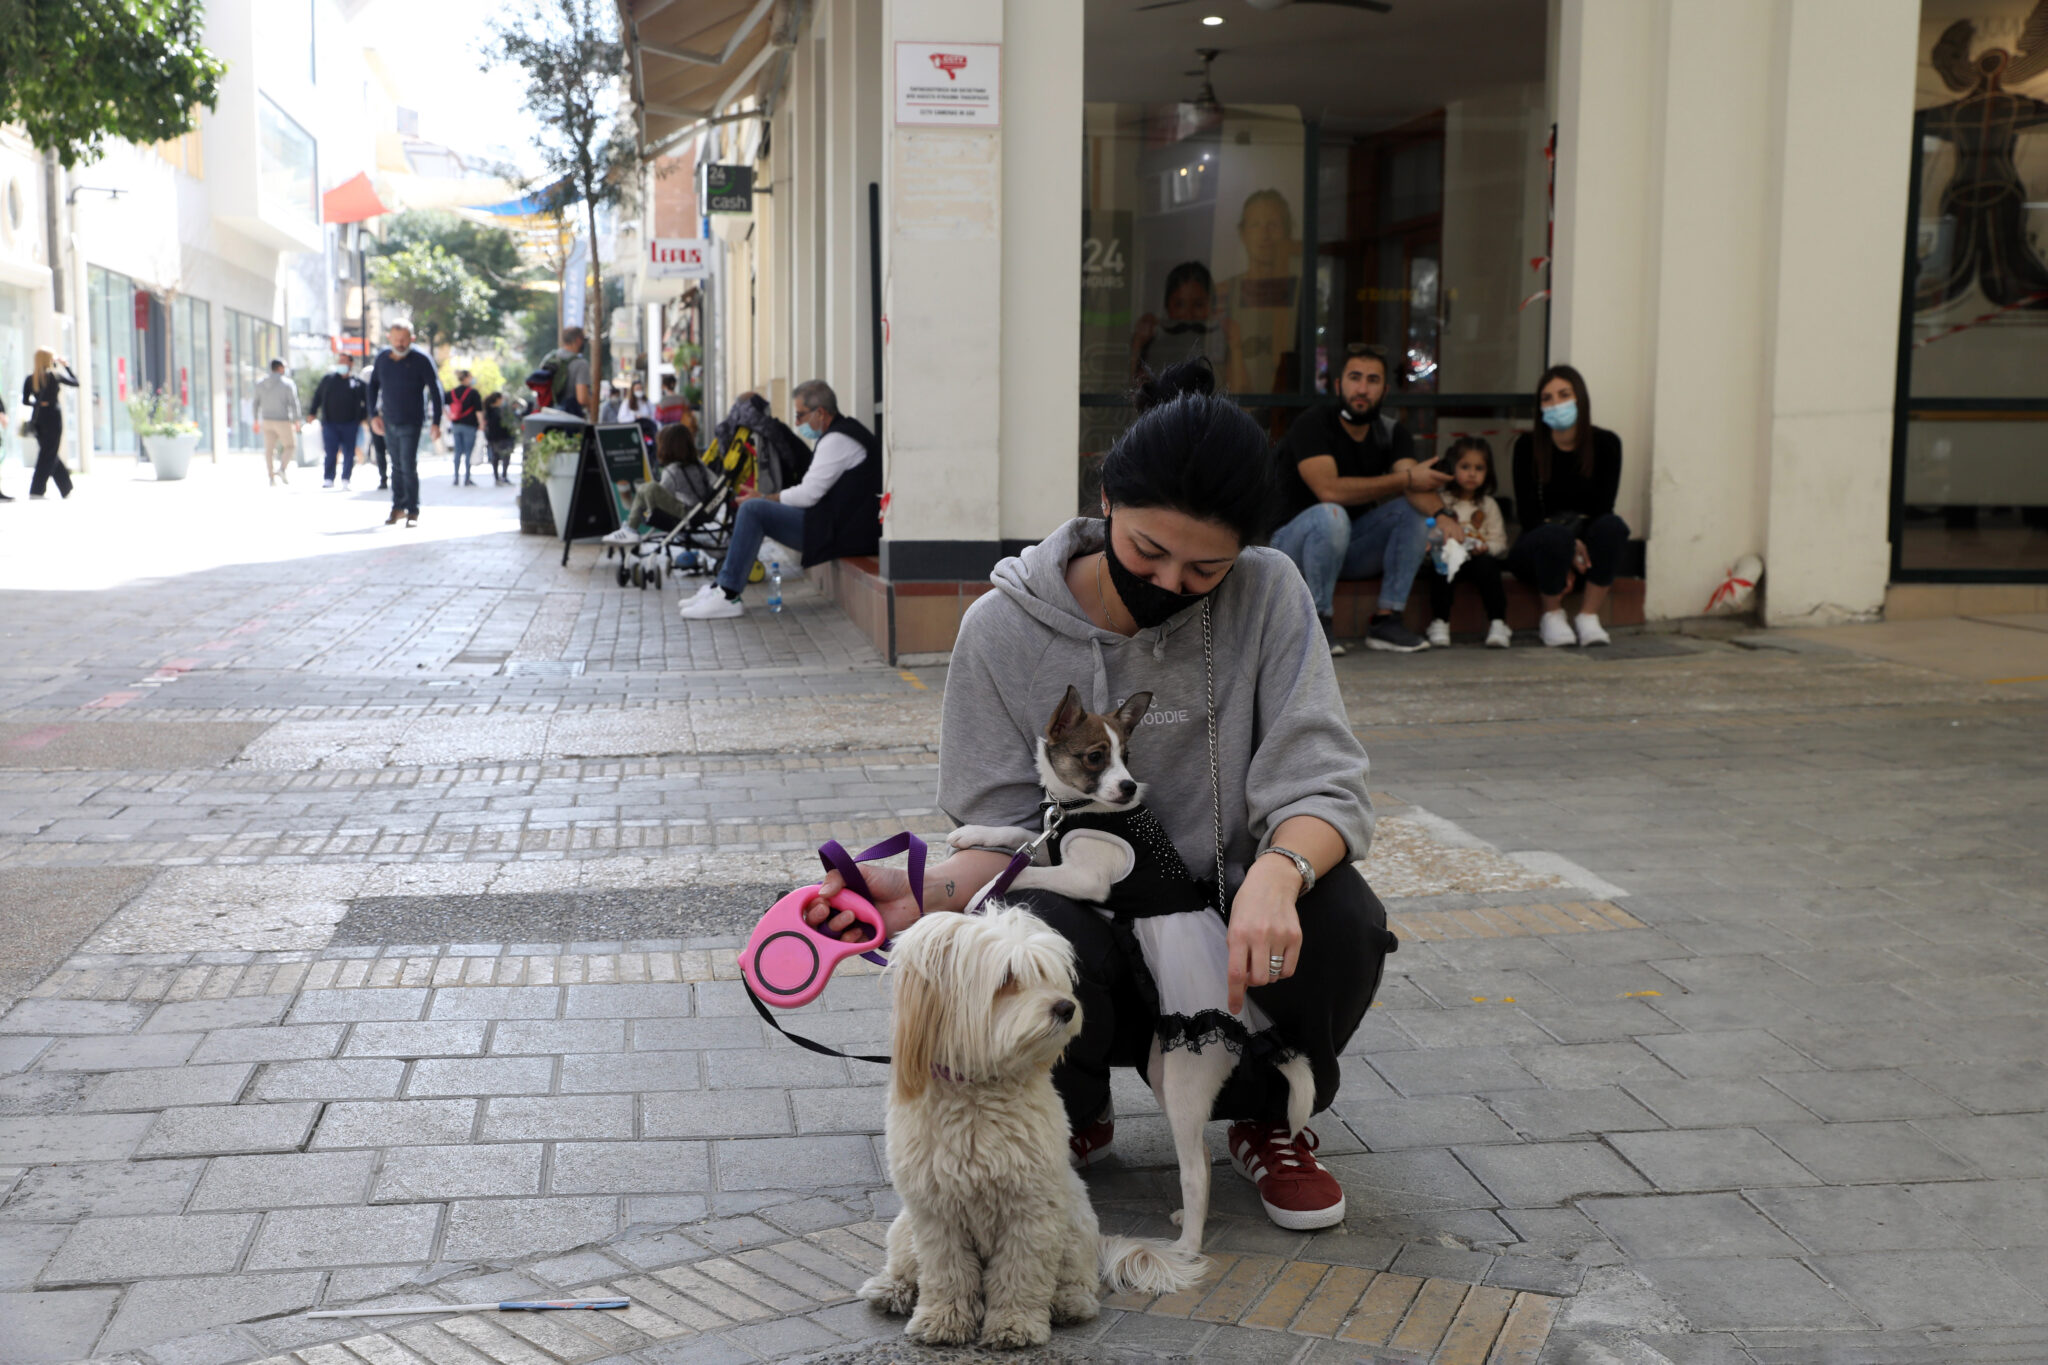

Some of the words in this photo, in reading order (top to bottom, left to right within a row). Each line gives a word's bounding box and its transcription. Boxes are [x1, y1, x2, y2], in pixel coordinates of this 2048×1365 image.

[709, 166, 726, 179] 24
[711, 195, 747, 209] cash
[1083, 238, 1125, 272] 24
